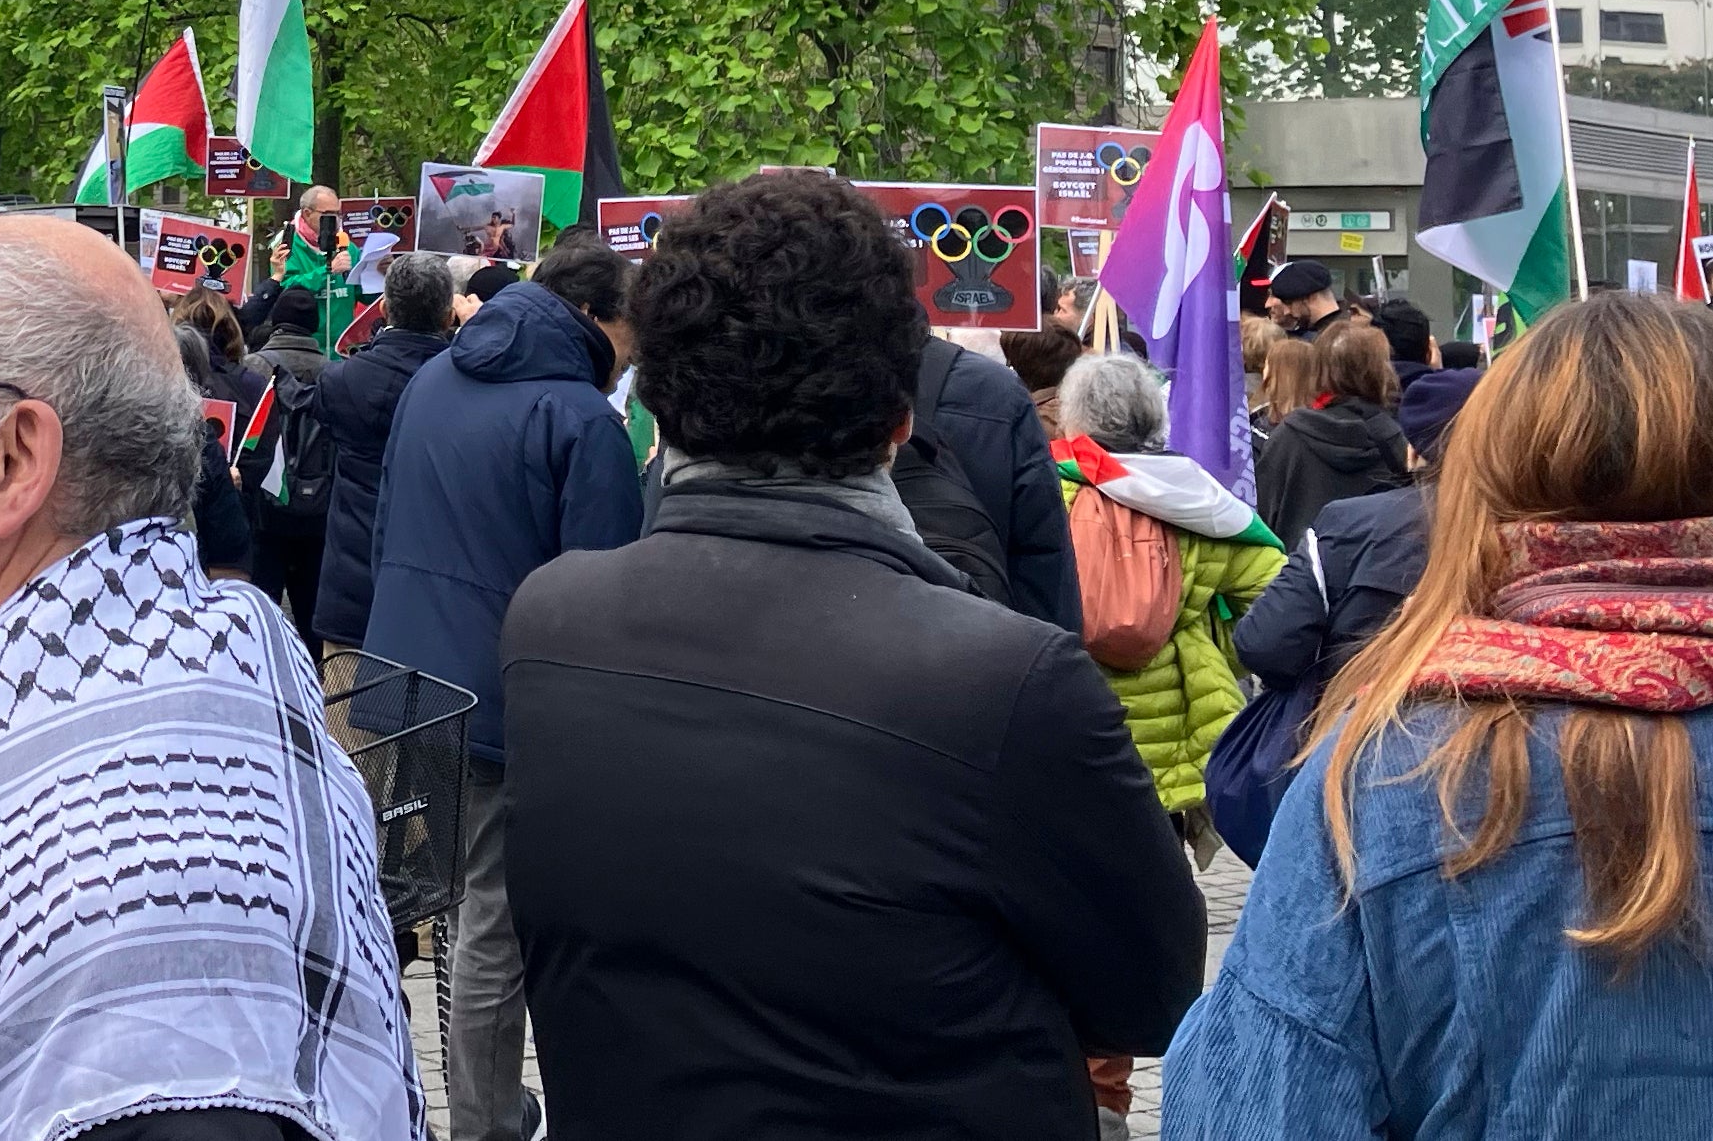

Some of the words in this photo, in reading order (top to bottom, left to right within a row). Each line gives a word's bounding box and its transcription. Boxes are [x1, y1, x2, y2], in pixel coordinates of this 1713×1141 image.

[1052, 181, 1097, 190] BOYCOTT
[953, 290, 994, 304] ISRAEL
[382, 799, 429, 822] BASIL
